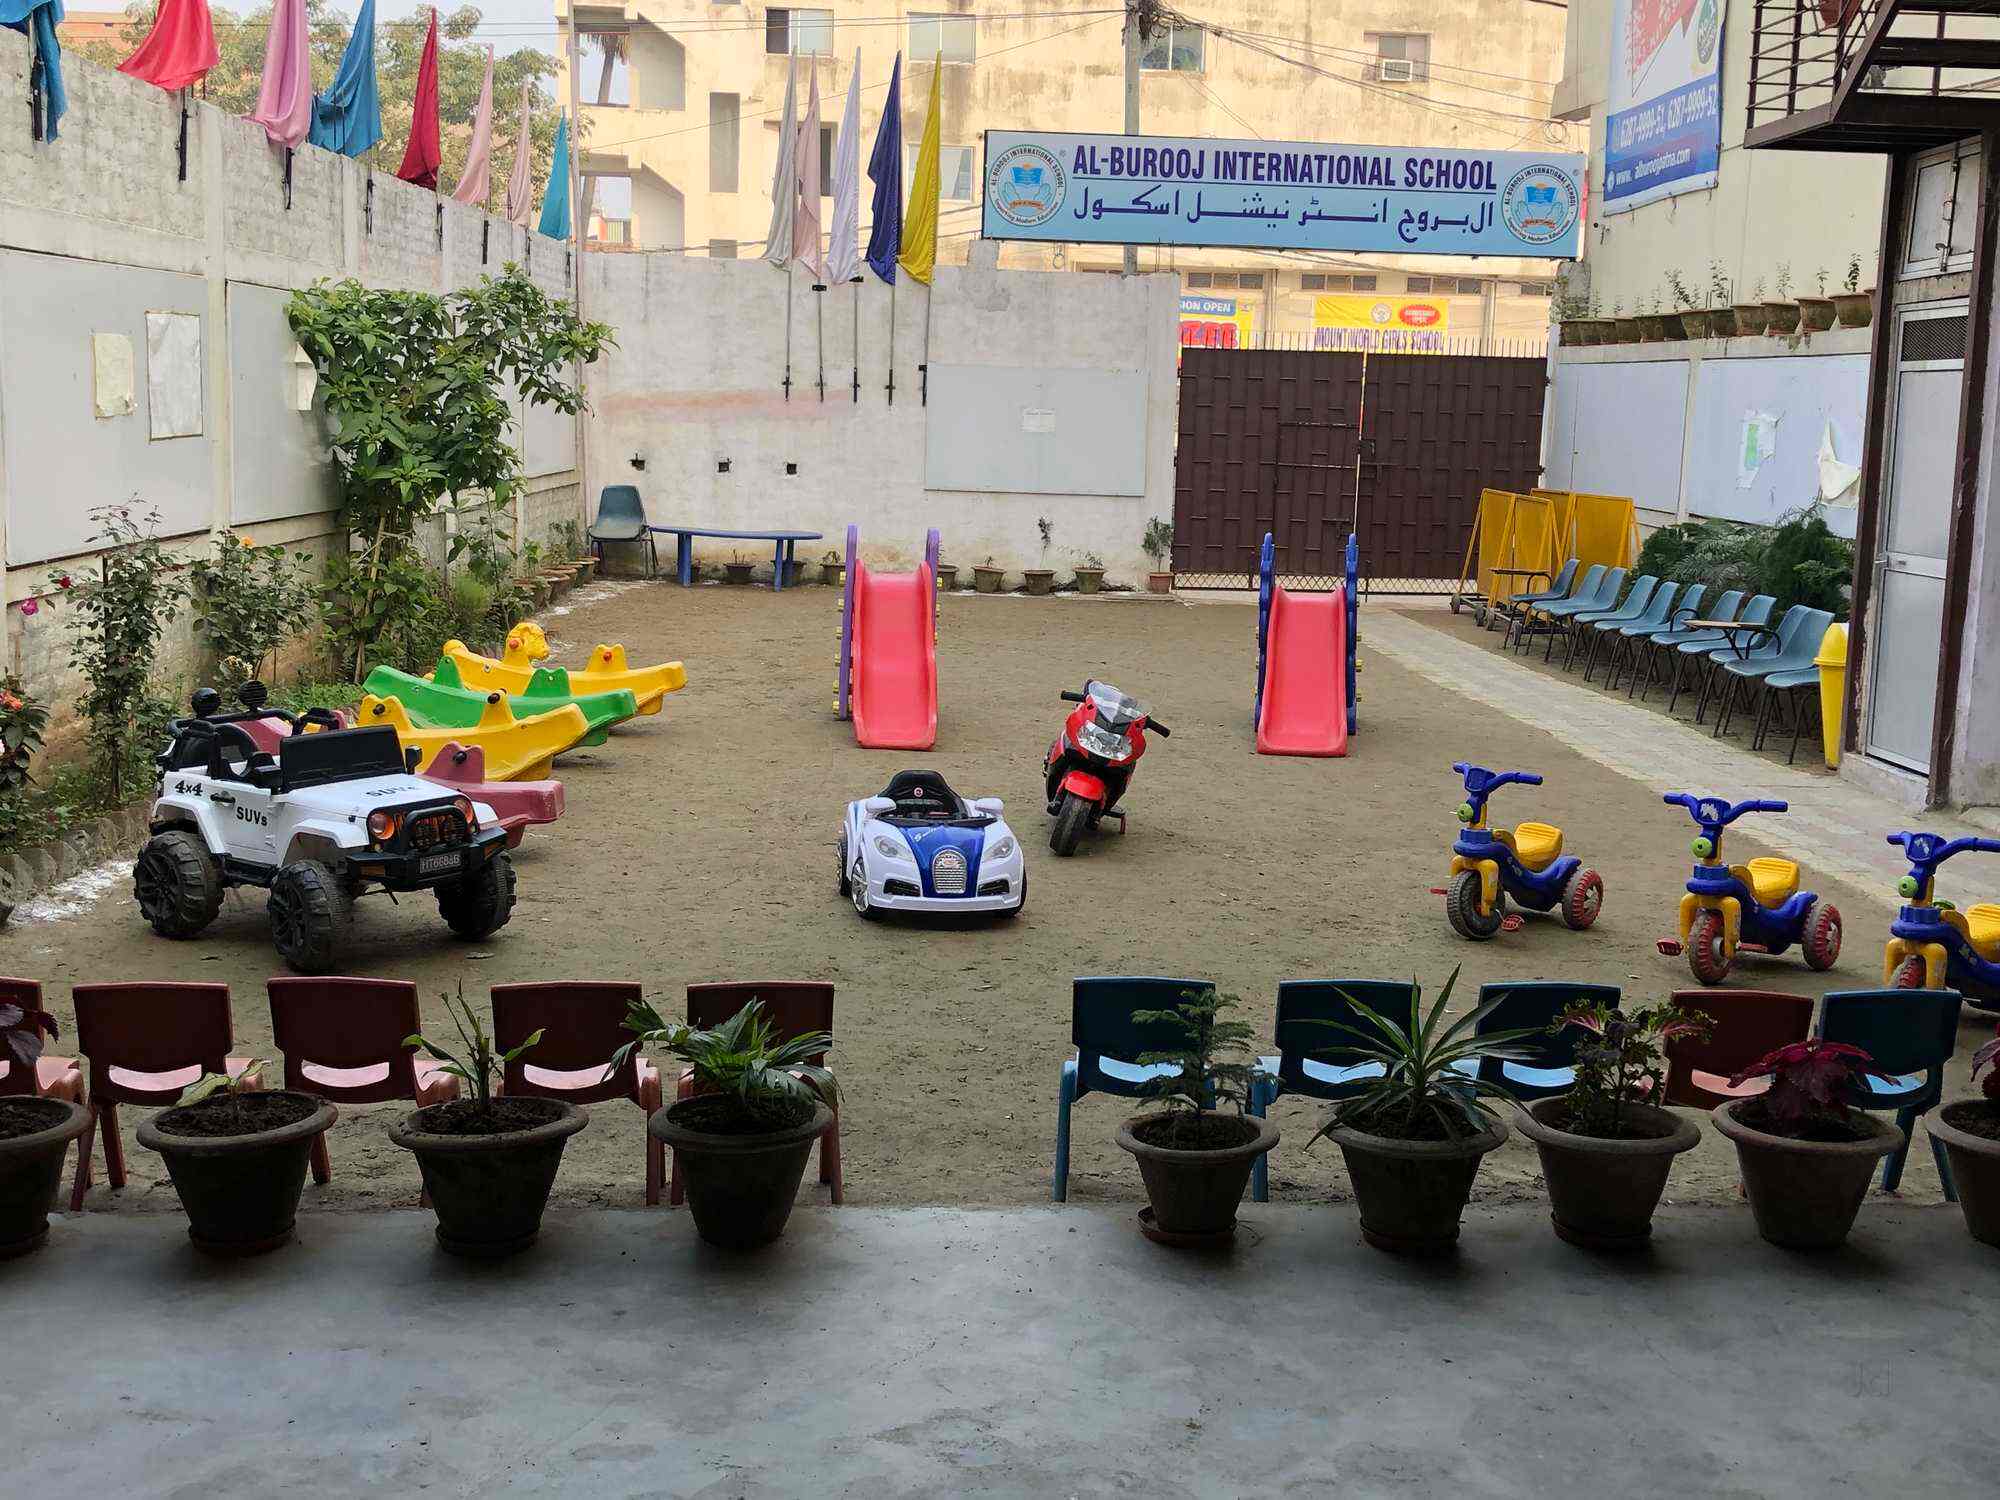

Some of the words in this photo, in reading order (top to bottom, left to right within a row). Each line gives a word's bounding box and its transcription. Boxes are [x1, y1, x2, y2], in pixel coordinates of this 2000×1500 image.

[1073, 145, 1205, 180] AL-BUROOJ
[1214, 151, 1396, 187] INTERNATIONAL
[1404, 158, 1497, 190] SCHOOL
[1203, 302, 1231, 313] OPEN
[175, 780, 204, 797] 4x4
[236, 806, 268, 827] SUVs
